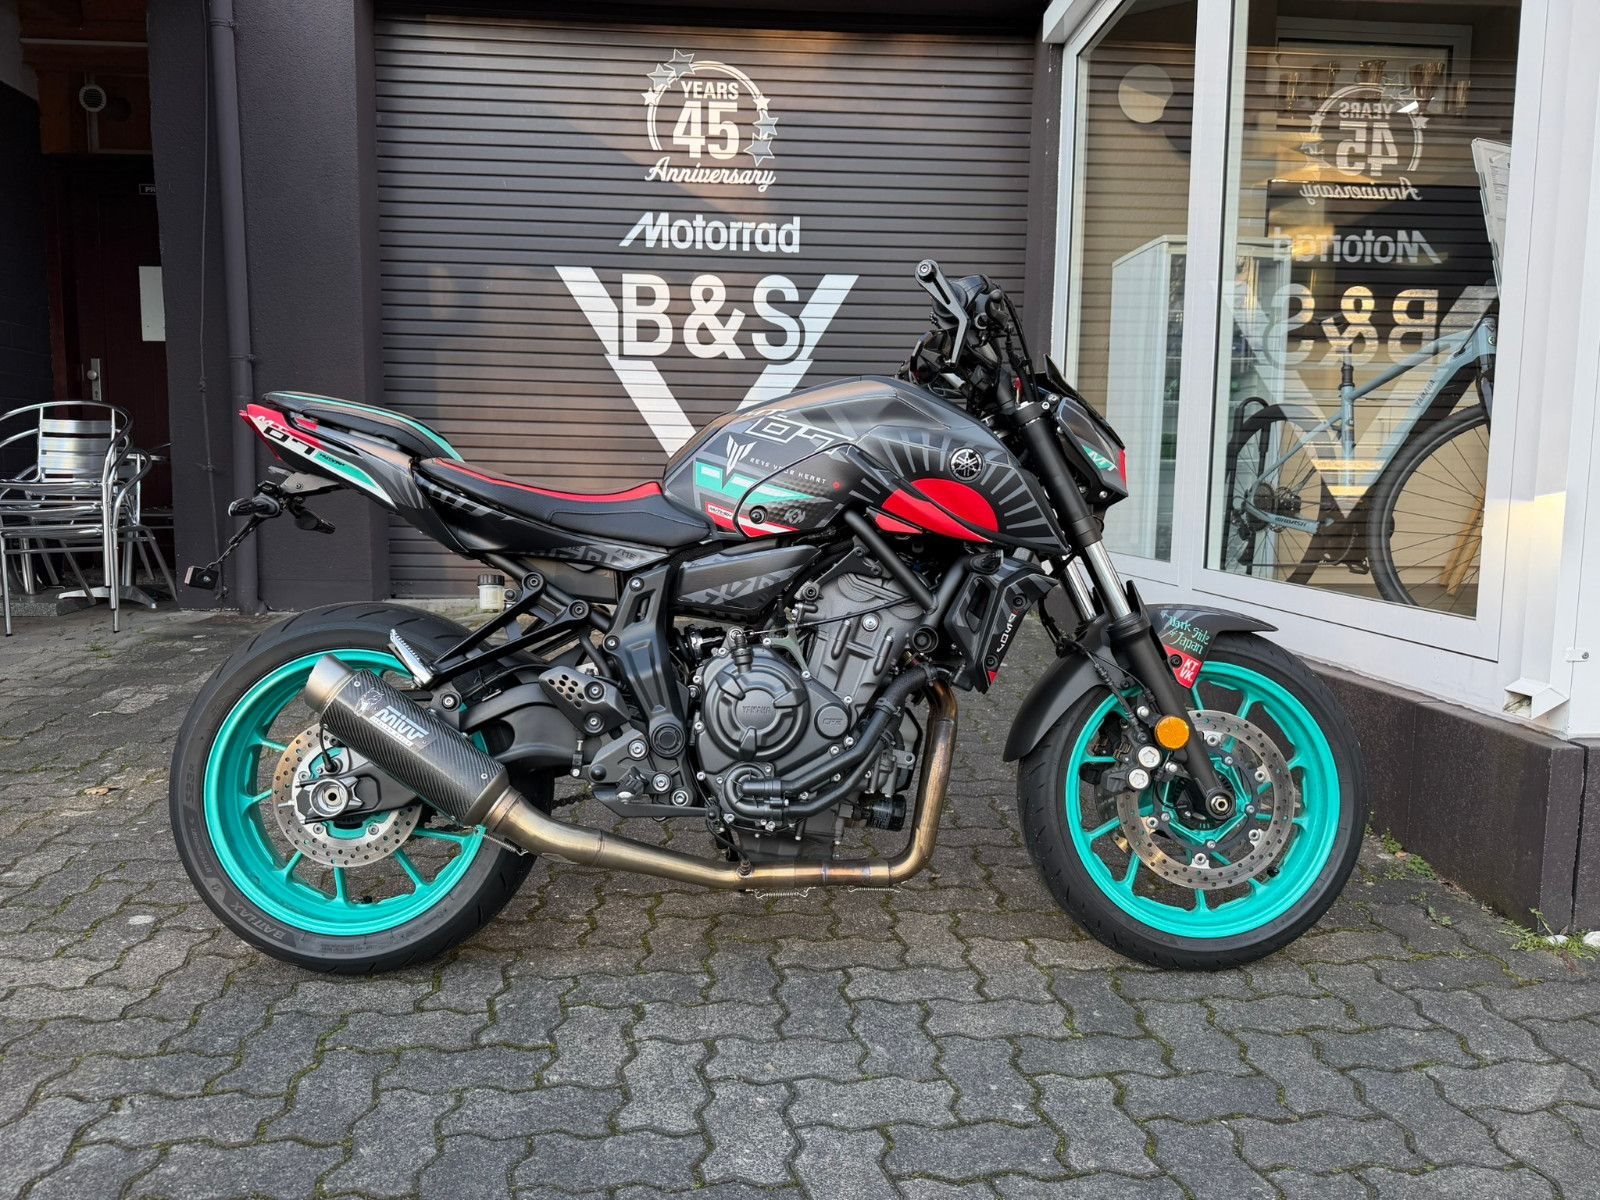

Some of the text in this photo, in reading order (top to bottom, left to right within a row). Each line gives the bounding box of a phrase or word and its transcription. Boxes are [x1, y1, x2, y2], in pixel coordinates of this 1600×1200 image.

[680, 81, 739, 99] YEARS
[672, 101, 740, 159] 45
[644, 157, 776, 192] Anniversary
[619, 212, 800, 253] Motorrad
[263, 426, 315, 456] 07
[1169, 631, 1204, 655] Japan
[1183, 658, 1199, 671] KT
